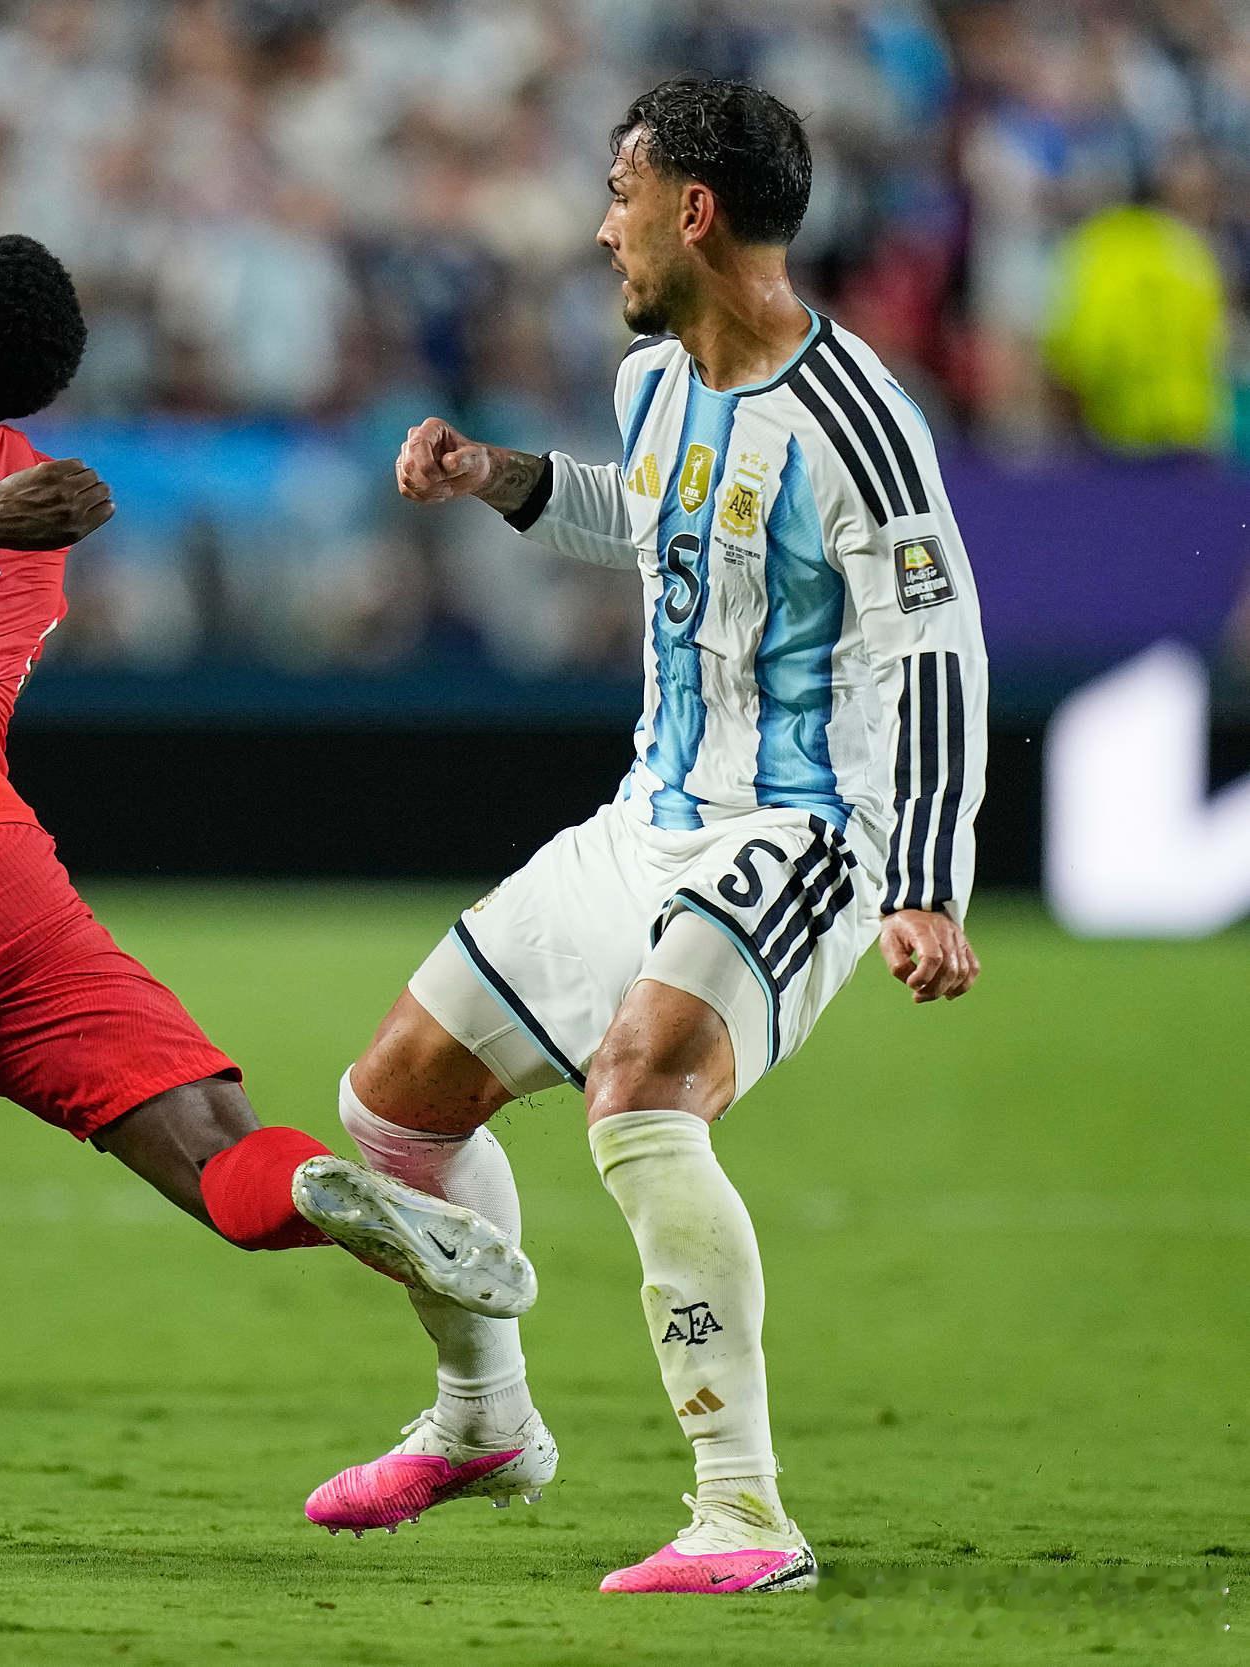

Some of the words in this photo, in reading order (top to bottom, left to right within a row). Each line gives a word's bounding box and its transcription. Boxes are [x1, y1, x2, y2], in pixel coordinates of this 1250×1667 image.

[684, 487, 699, 499] FIFA
[729, 487, 754, 520] AFA
[665, 533, 700, 625] 5
[717, 838, 788, 908] 5
[661, 1301, 723, 1347] AFA
